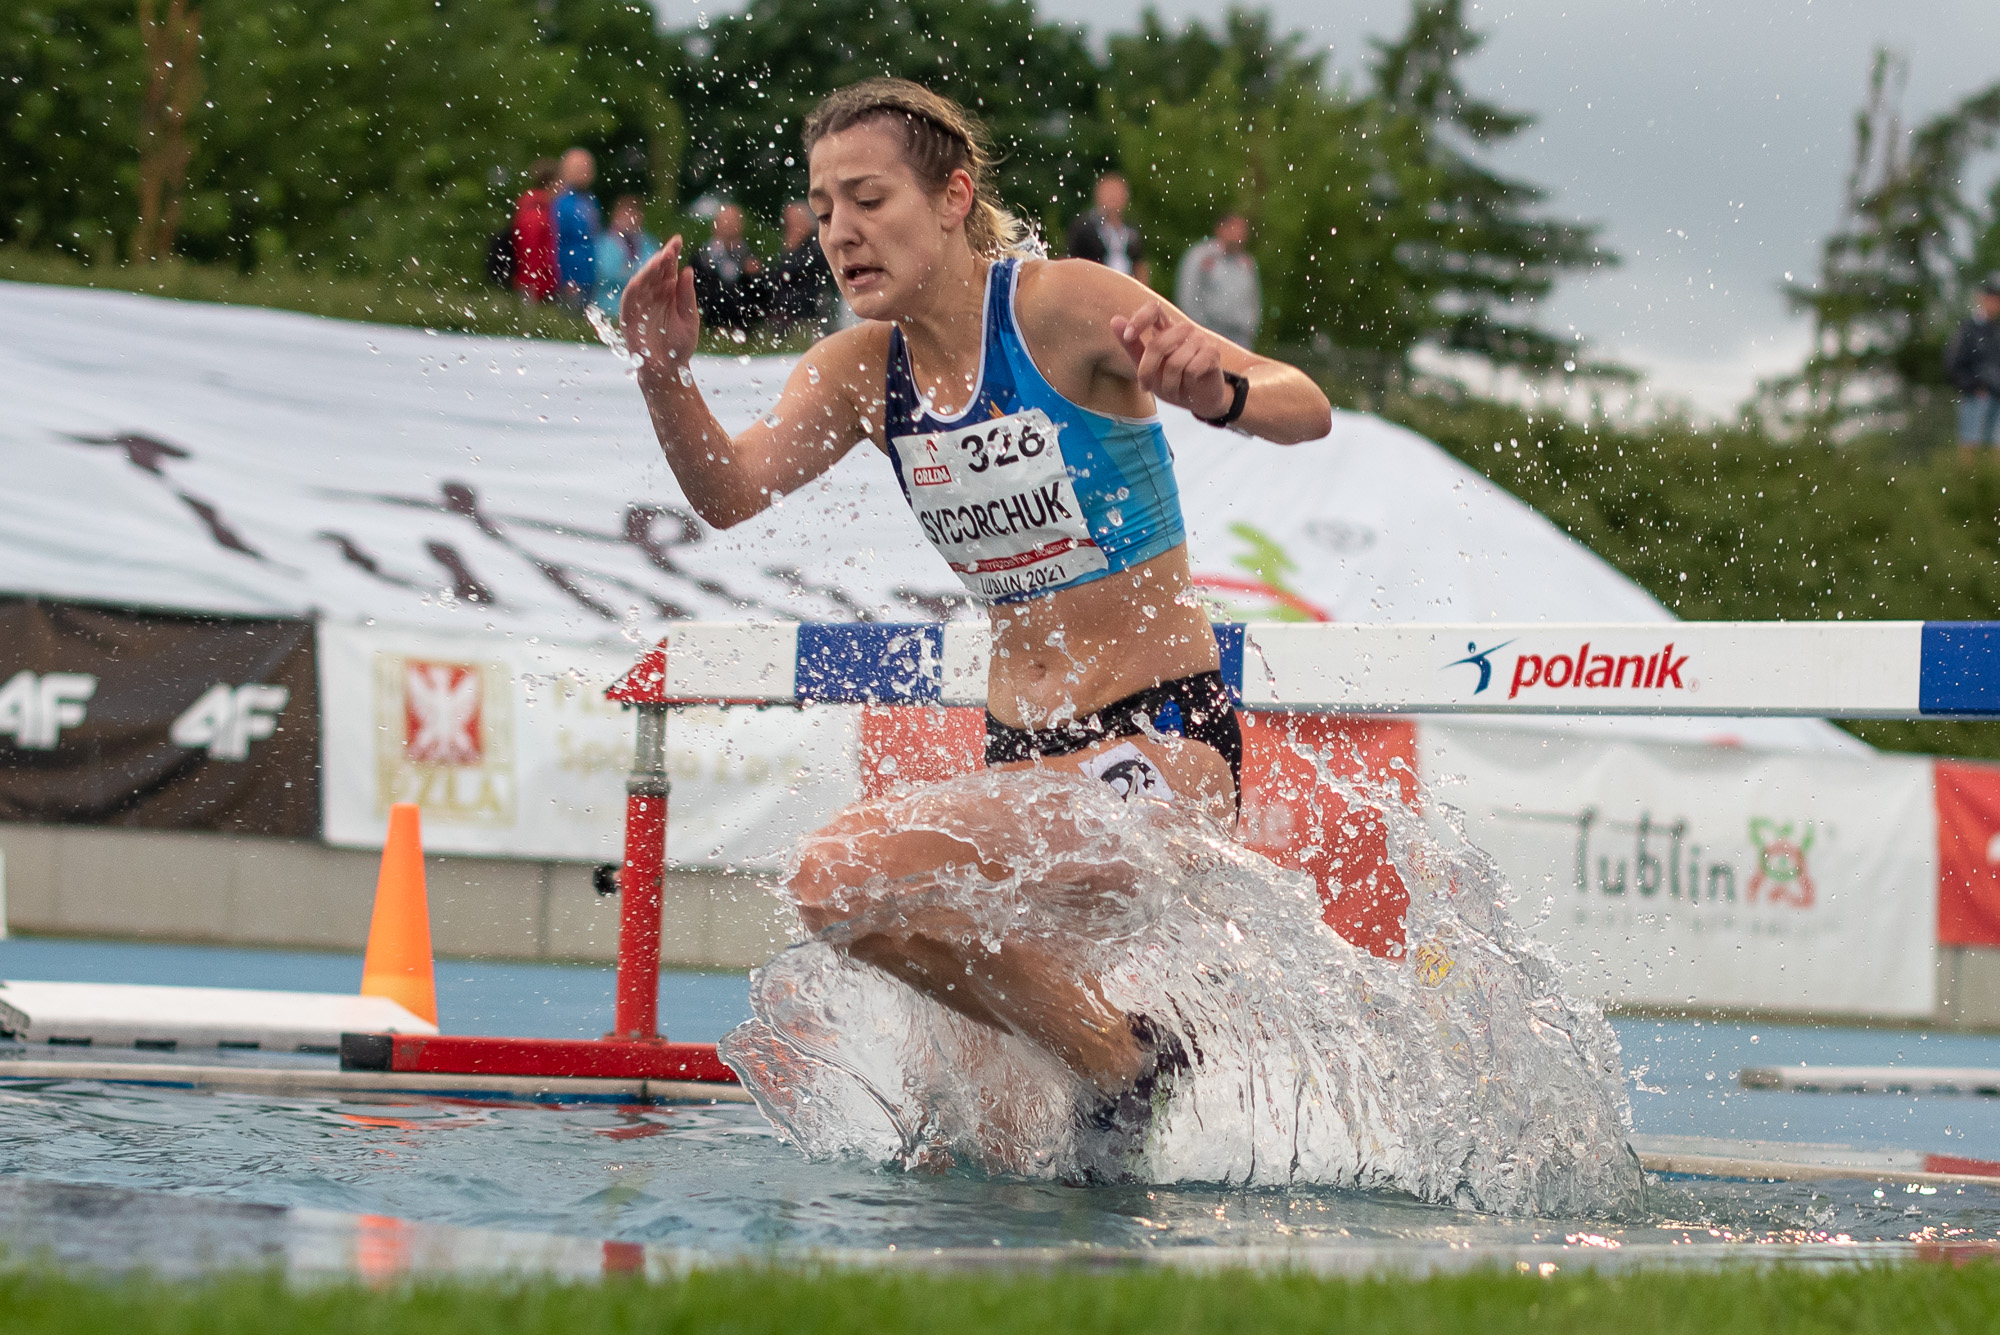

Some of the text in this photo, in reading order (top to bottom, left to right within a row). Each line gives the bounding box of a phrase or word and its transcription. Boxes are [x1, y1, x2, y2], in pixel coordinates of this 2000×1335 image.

[961, 425, 1046, 473] 326
[920, 481, 1073, 546] SYDORCHUK
[1508, 642, 1690, 700] polanik
[0, 669, 291, 762] 4F 4F
